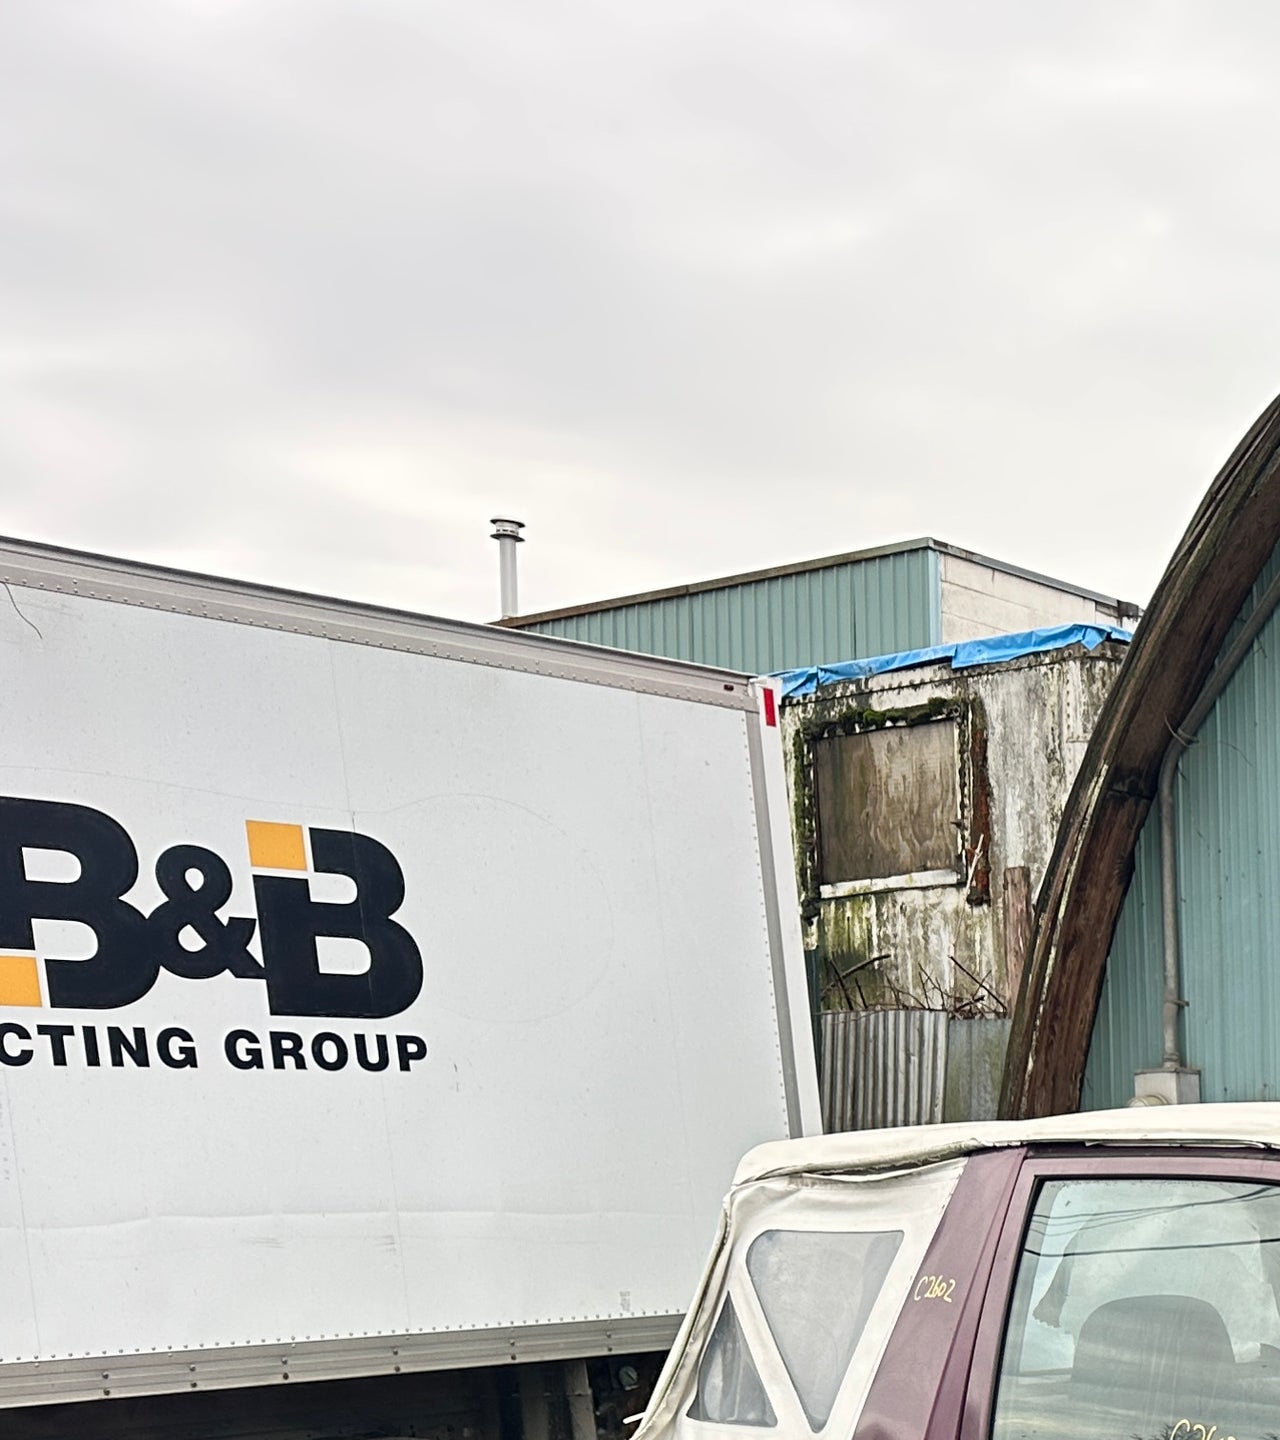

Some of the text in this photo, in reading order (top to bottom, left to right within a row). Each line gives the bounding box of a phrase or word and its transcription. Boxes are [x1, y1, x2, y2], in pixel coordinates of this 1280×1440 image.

[0, 796, 424, 1020] B&B
[224, 1028, 428, 1072] GROUP
[914, 1275, 956, 1302] C2602
